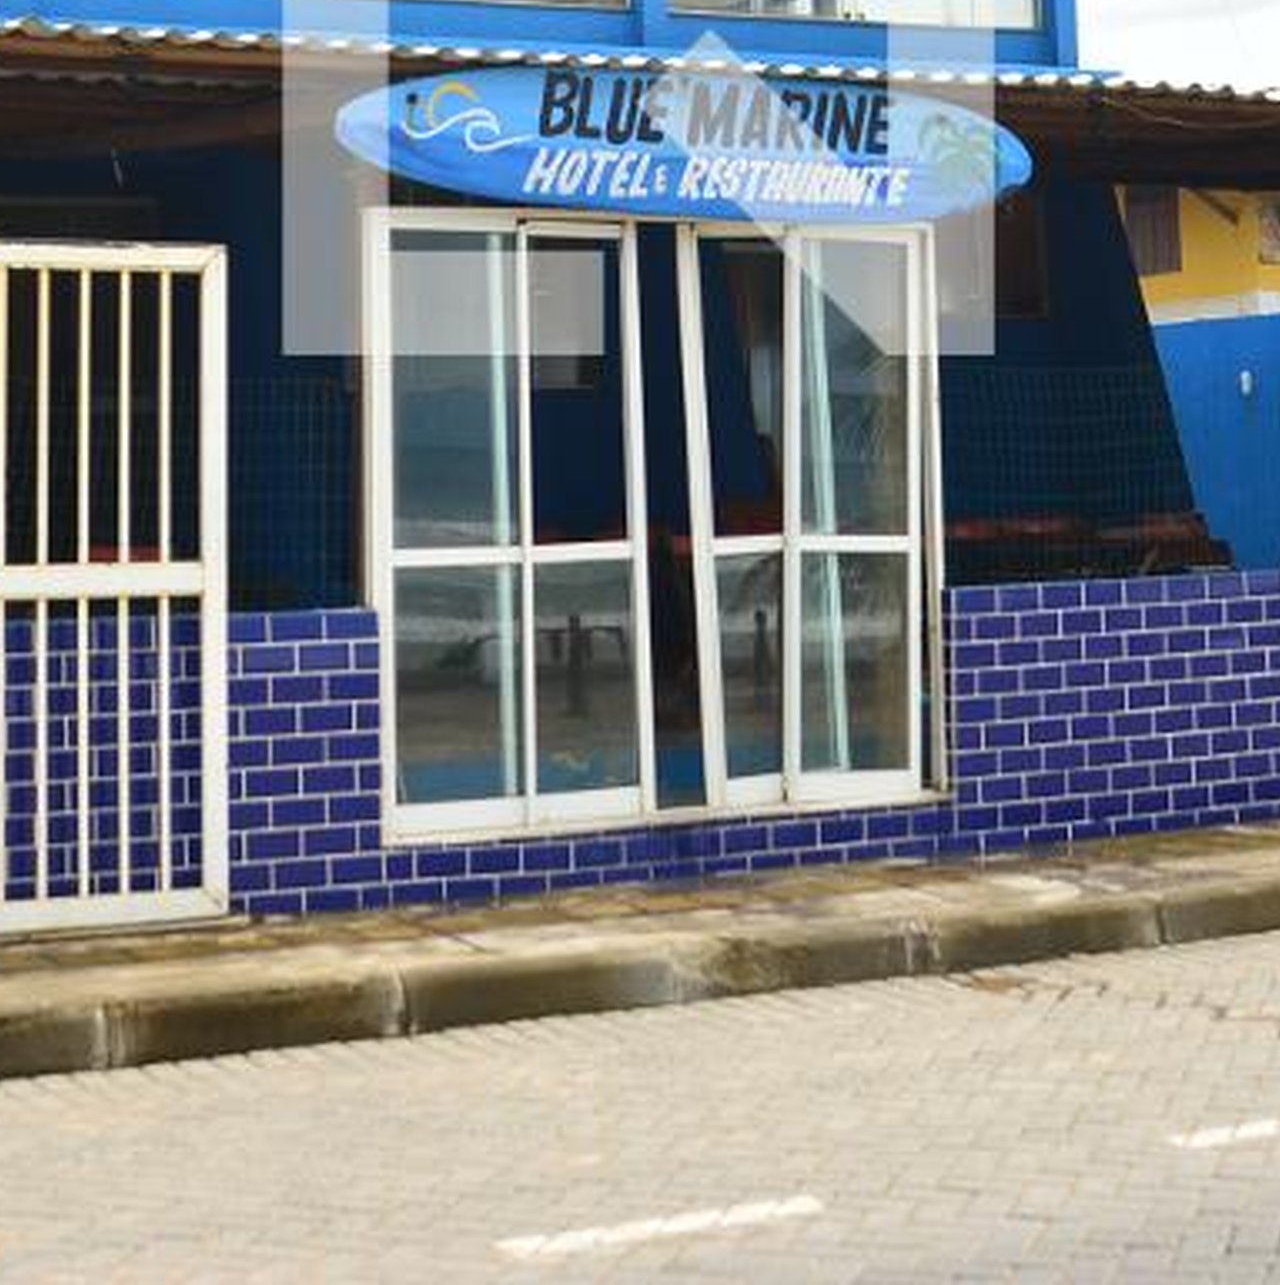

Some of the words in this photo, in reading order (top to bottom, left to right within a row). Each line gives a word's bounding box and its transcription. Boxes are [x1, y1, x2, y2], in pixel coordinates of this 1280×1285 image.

[539, 69, 675, 144] BLUE
[686, 79, 890, 156] MARINE
[523, 147, 650, 198] HOTEL
[677, 155, 911, 206] RESTAURANTE
